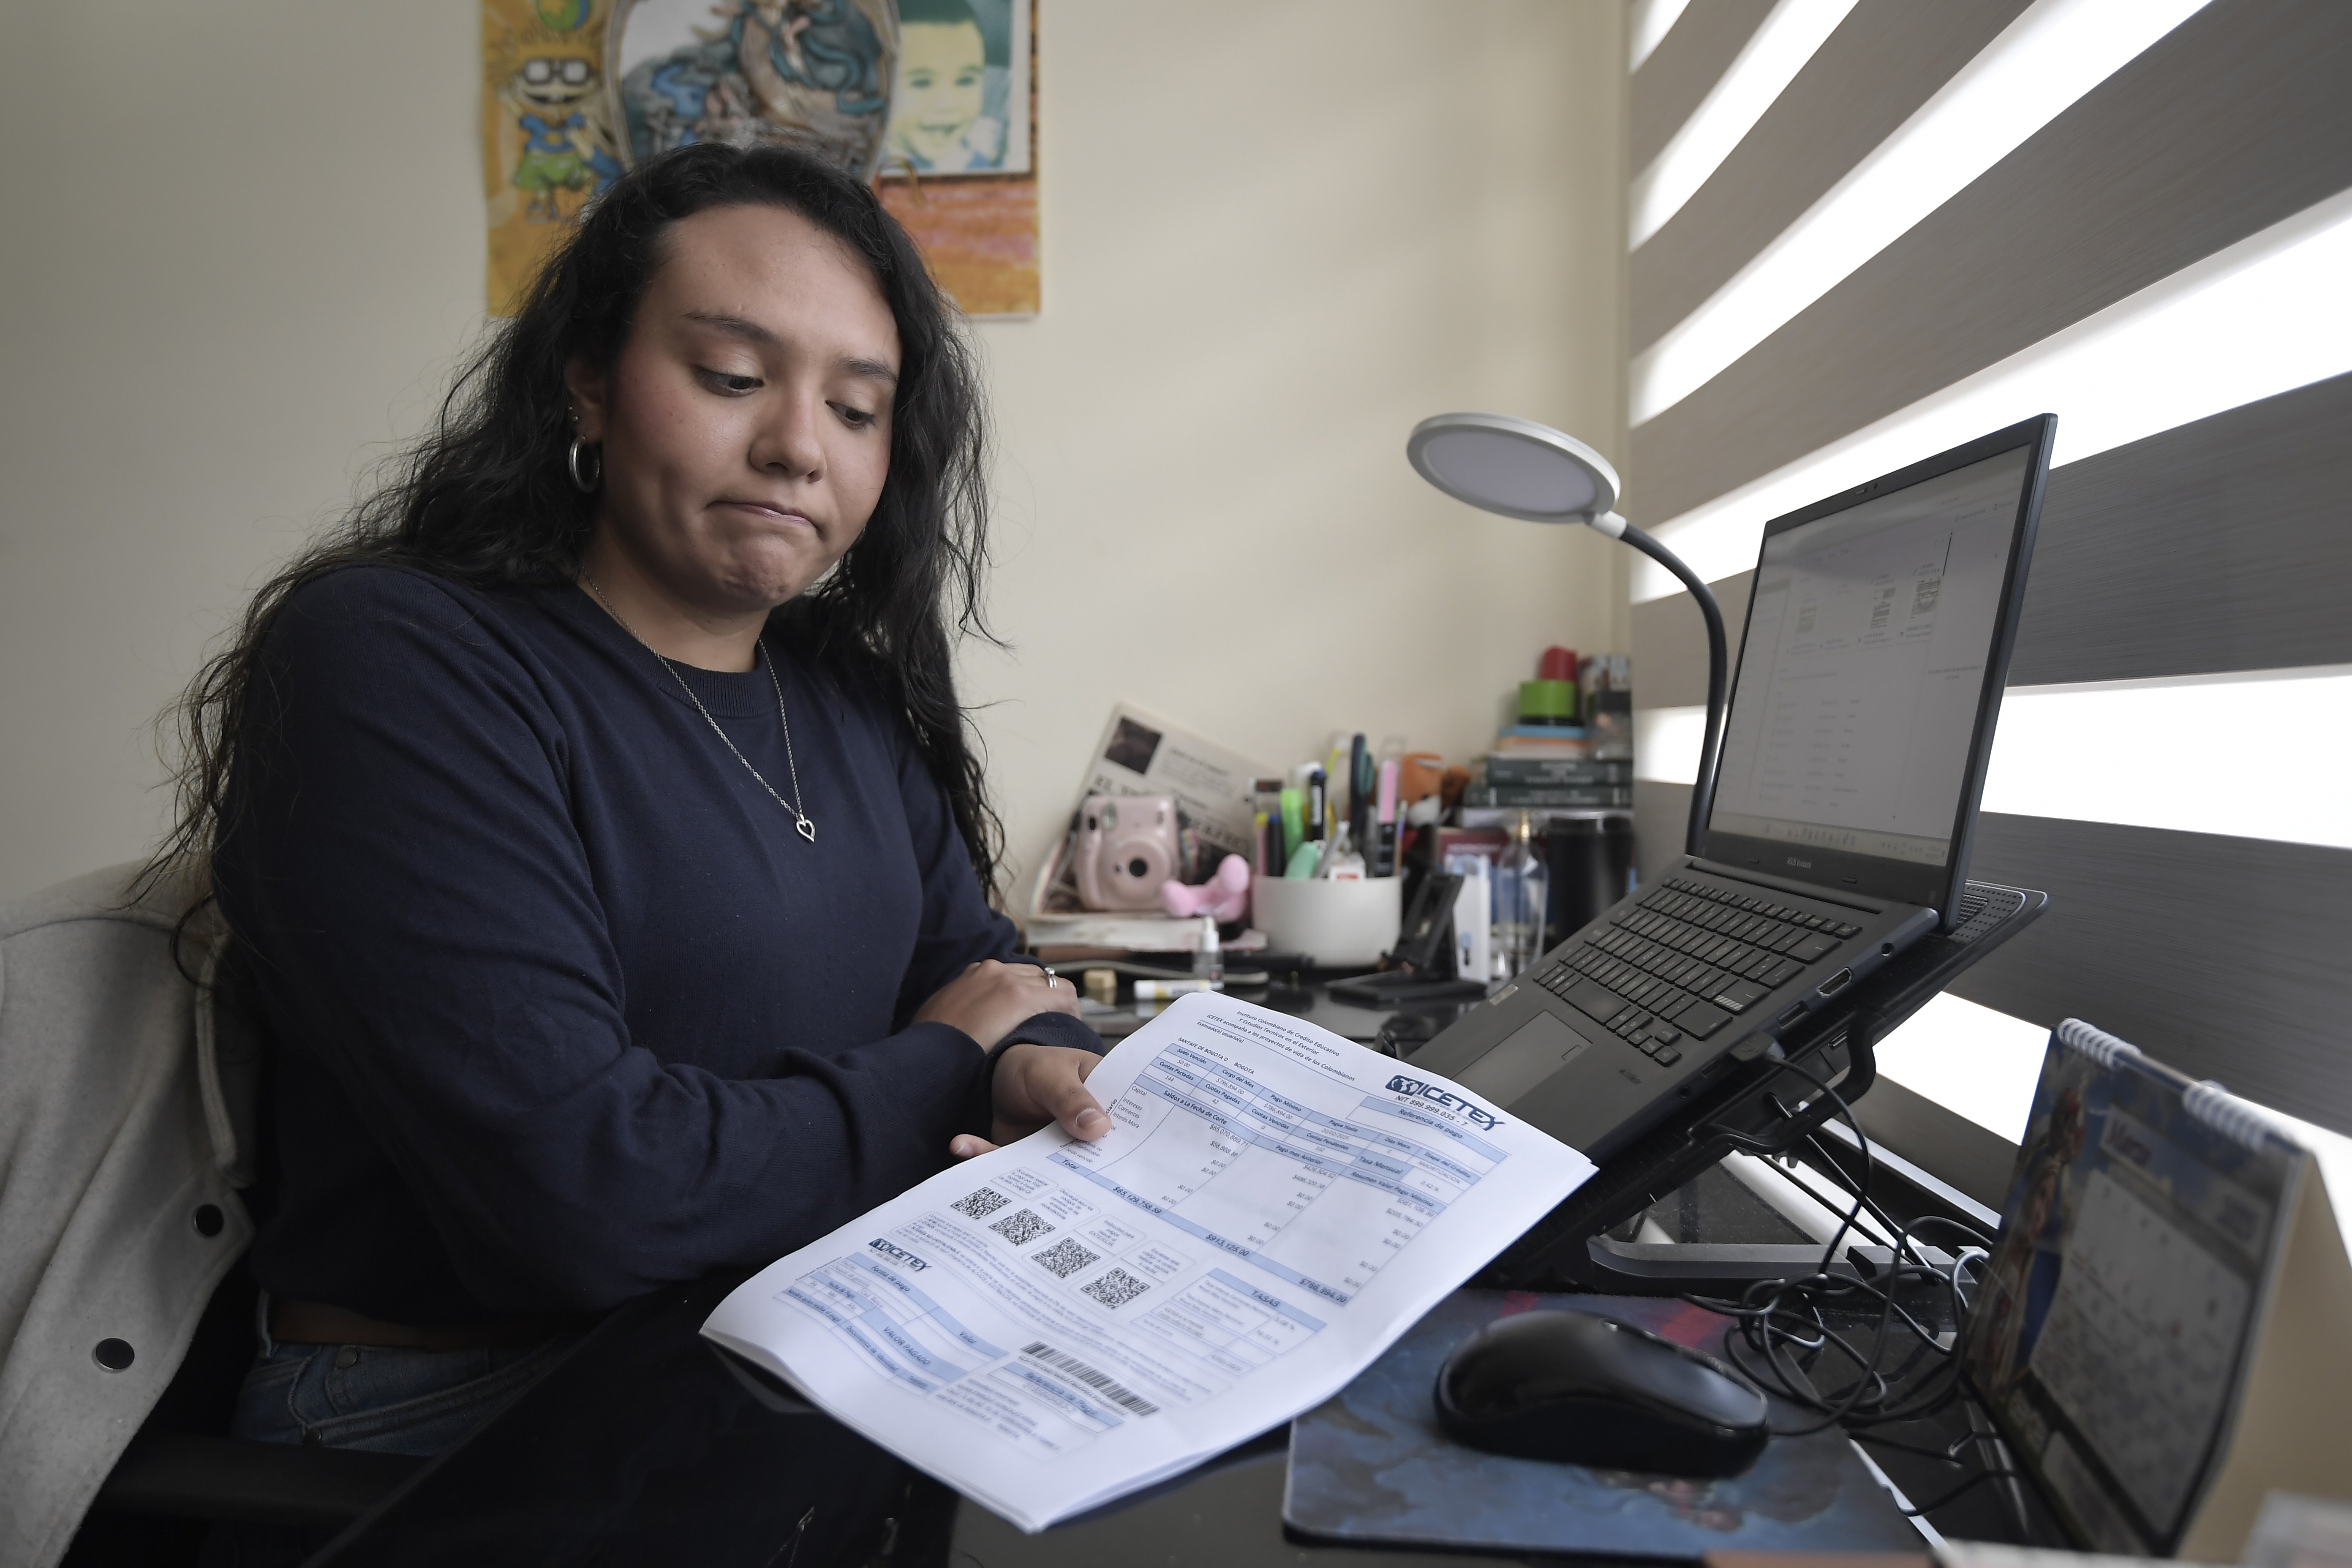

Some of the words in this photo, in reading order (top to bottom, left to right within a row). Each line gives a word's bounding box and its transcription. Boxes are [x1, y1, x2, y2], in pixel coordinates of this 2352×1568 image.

[1196, 1021, 1222, 1034] Estimado(a)
[1222, 1031, 1244, 1043] usuario(a)
[1237, 1011, 1257, 1021] Instituto
[1258, 1018, 1287, 1032] Colombiano
[1295, 1032, 1313, 1044] Credito
[1314, 1041, 1339, 1056] Educativo
[1243, 1019, 1262, 1030] Estudios
[1263, 1027, 1285, 1039] Tecnicos
[1298, 1043, 1319, 1055] Exterior
[1178, 1037, 1197, 1048] SANTAFE
[1204, 1048, 1223, 1059] BOGOTA
[1233, 1062, 1255, 1075] BOGOTA
[1206, 1014, 1222, 1023] ICETEX
[1222, 1020, 1247, 1033] acompaña
[1259, 1034, 1284, 1048] proyectos
[1293, 1049, 1304, 1058] vida
[1320, 1063, 1355, 1081] Colombianos
[1190, 1054, 1206, 1064] Vencido
[1159, 1062, 1173, 1071] Cuotas
[1174, 1068, 1194, 1081] Pactadas
[1222, 1070, 1236, 1078] Cargo
[1244, 1080, 1254, 1088] Mes
[1131, 1086, 1147, 1097] Capital
[1205, 1083, 1220, 1093] Cuotas
[1221, 1091, 1240, 1104] Pagadas
[1216, 1078, 1244, 1094] $786,894.00
[1123, 1097, 1142, 1111] Intereses
[1163, 1090, 1179, 1102] Saldos
[1190, 1103, 1205, 1113] Fecha
[1212, 1114, 1227, 1124] Corte
[1270, 1094, 1282, 1103] Pago
[1283, 1100, 1301, 1112] Mínimo
[1396, 1095, 1410, 1103] NIT
[1416, 1084, 1505, 1131] ICETEX
[1113, 1112, 1127, 1123] Interés
[1128, 1119, 1139, 1128] Mora
[1118, 1104, 1140, 1119] Corrientes
[1251, 1108, 1268, 1119] Cuotas
[1268, 1117, 1289, 1130] Vencidas
[1263, 1103, 1293, 1120] $786,894.00
[1399, 1109, 1435, 1125] Referencia
[1445, 1127, 1462, 1139] pago
[1306, 1133, 1323, 1141] Cuotas
[1323, 1138, 1348, 1150] Pendientes
[1321, 1128, 1350, 1140] 20/02/2025
[1275, 1145, 1288, 1154] Pago
[1301, 1154, 1323, 1165] Anterior
[1424, 1152, 1440, 1162] Etapa
[1062, 1159, 1080, 1170] Total
[1201, 1167, 1217, 1176] $0.00
[1211, 1160, 1226, 1168] $0.00
[1358, 1156, 1372, 1164] Tasa
[1375, 1161, 1403, 1174] Mensual
[1178, 1184, 1193, 1192] $0.00
[1351, 1171, 1376, 1183] Resumen
[1378, 1180, 1394, 1190] Valor
[1394, 1186, 1409, 1195] Pago
[1162, 1195, 1177, 1204] $0.00
[1089, 1230, 1114, 1246] EXTERIOR
[1206, 1234, 1249, 1257] $913,125.00
[871, 1265, 888, 1277] Forma
[894, 1278, 910, 1292] pago
[1251, 1290, 1280, 1307] TASAS
[883, 1326, 905, 1346] VALOR
[903, 1344, 931, 1364] PAGADO
[959, 1331, 977, 1345] Valor
